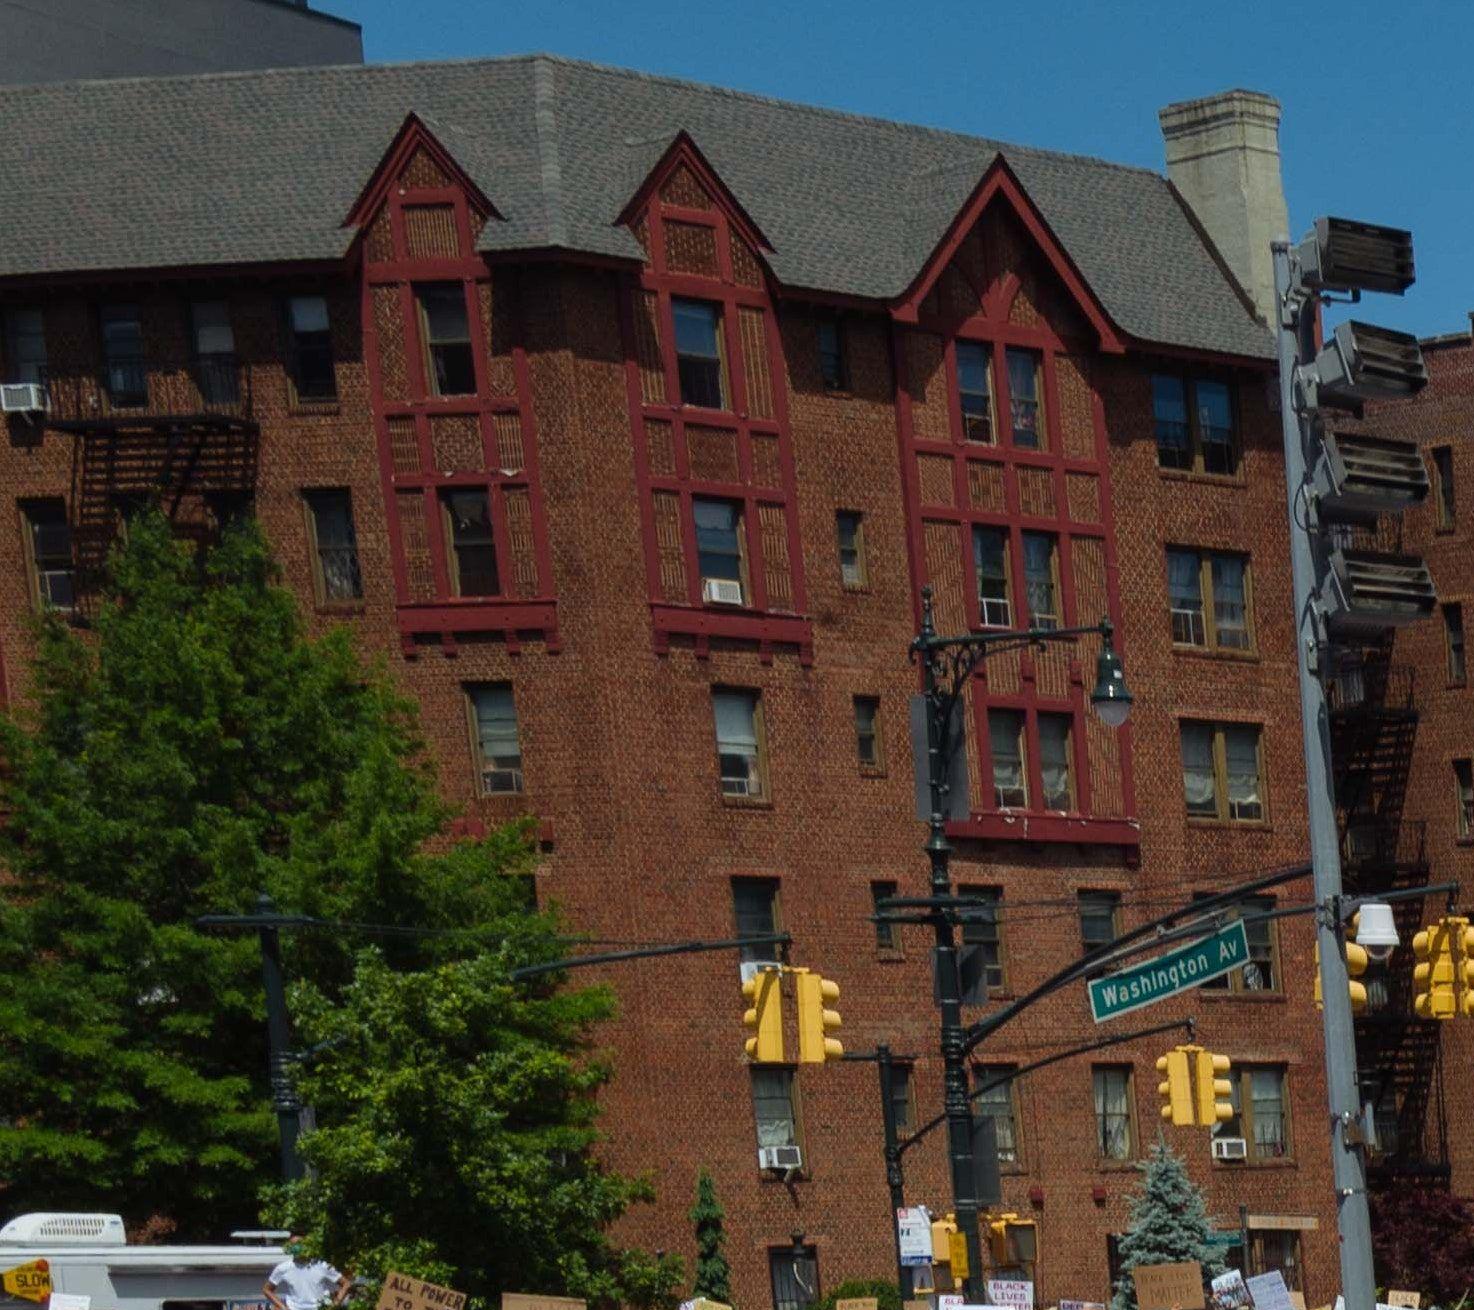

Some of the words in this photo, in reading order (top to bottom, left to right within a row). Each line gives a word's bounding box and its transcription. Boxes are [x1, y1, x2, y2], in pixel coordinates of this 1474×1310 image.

[1100, 956, 1208, 1010] Washington
[1216, 936, 1238, 960] Av
[17, 1273, 51, 1289] SLOW
[993, 1281, 1027, 1292] BLACK
[390, 1277, 413, 1294] ALL
[420, 1283, 464, 1309] POWER
[995, 1291, 1026, 1302] LIVES
[395, 1297, 413, 1310] TO
